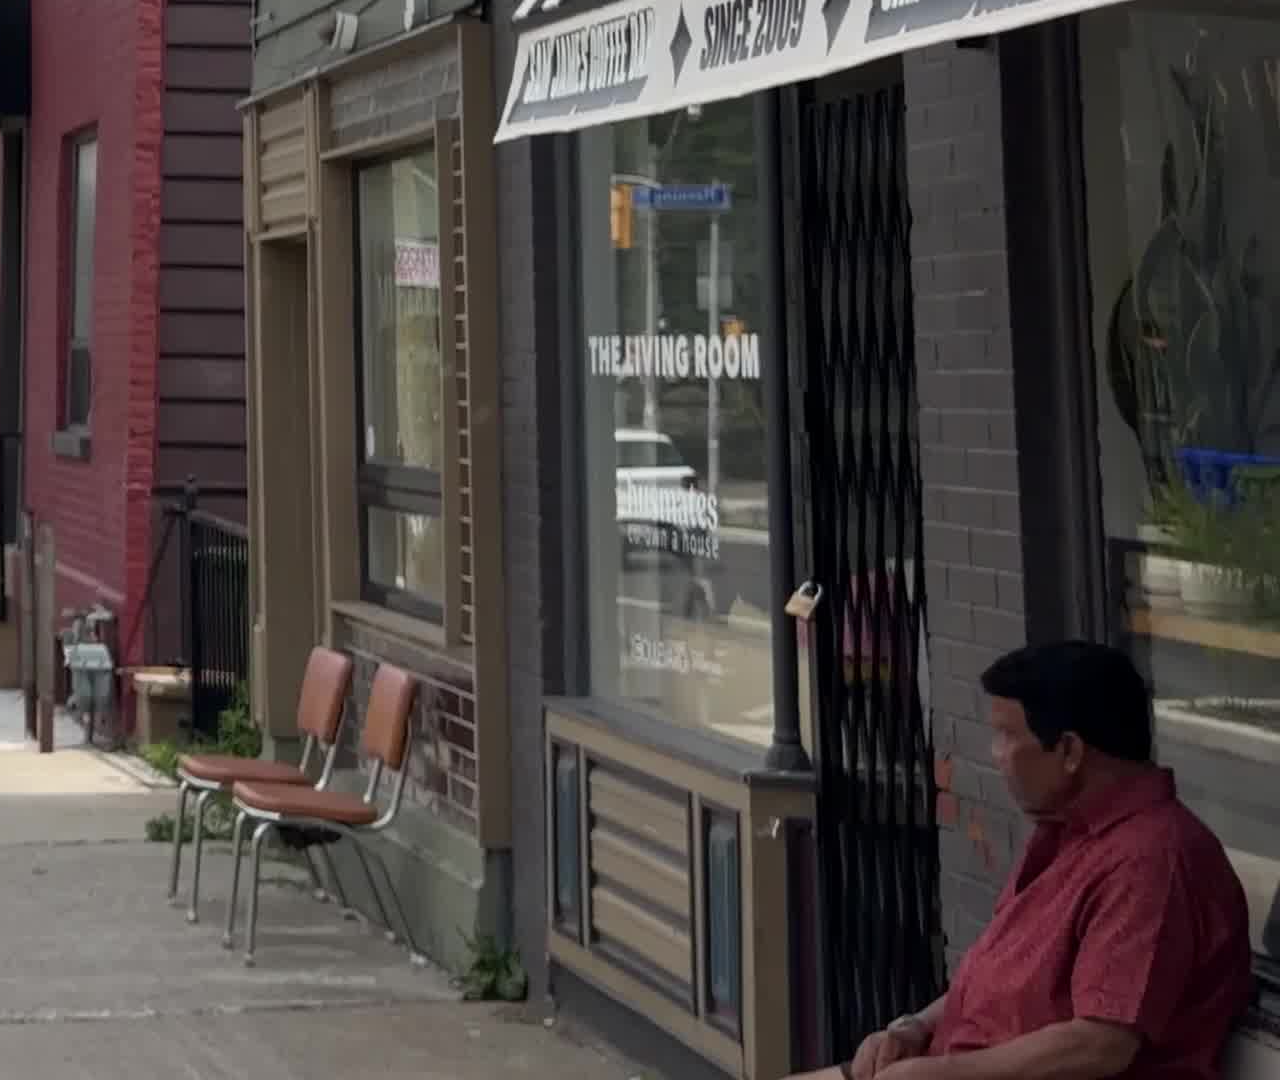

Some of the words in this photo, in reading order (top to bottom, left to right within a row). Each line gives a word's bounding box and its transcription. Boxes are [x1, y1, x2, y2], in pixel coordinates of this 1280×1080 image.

[523, 37, 555, 105] SAM
[550, 26, 589, 99] JAMES
[588, 16, 628, 93] COFFEE
[627, 6, 655, 82] BAR
[588, 335, 621, 377] THE
[622, 335, 689, 379] LIVING
[694, 333, 760, 379] ROOM
[681, 528, 720, 561] house
